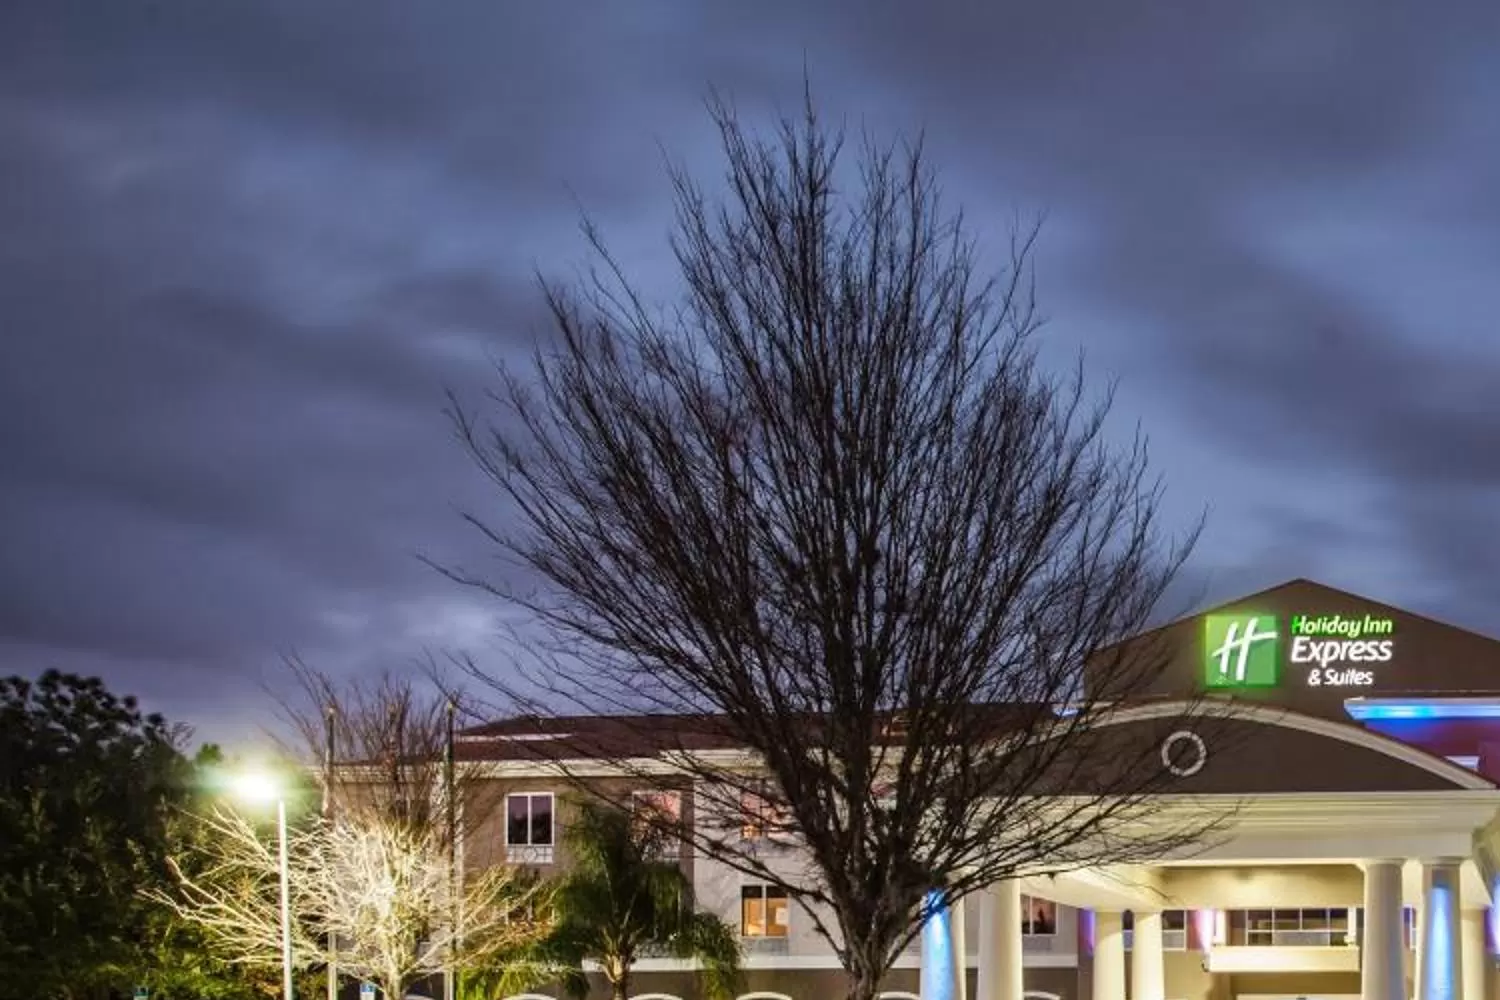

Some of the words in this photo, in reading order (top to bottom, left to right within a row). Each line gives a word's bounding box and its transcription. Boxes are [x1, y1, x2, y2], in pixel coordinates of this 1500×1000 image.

[1291, 615, 1362, 638] Holiday
[1362, 614, 1393, 634] Inn
[1291, 635, 1393, 668] Express
[1308, 668, 1321, 686] &
[1323, 668, 1374, 686] Suites
